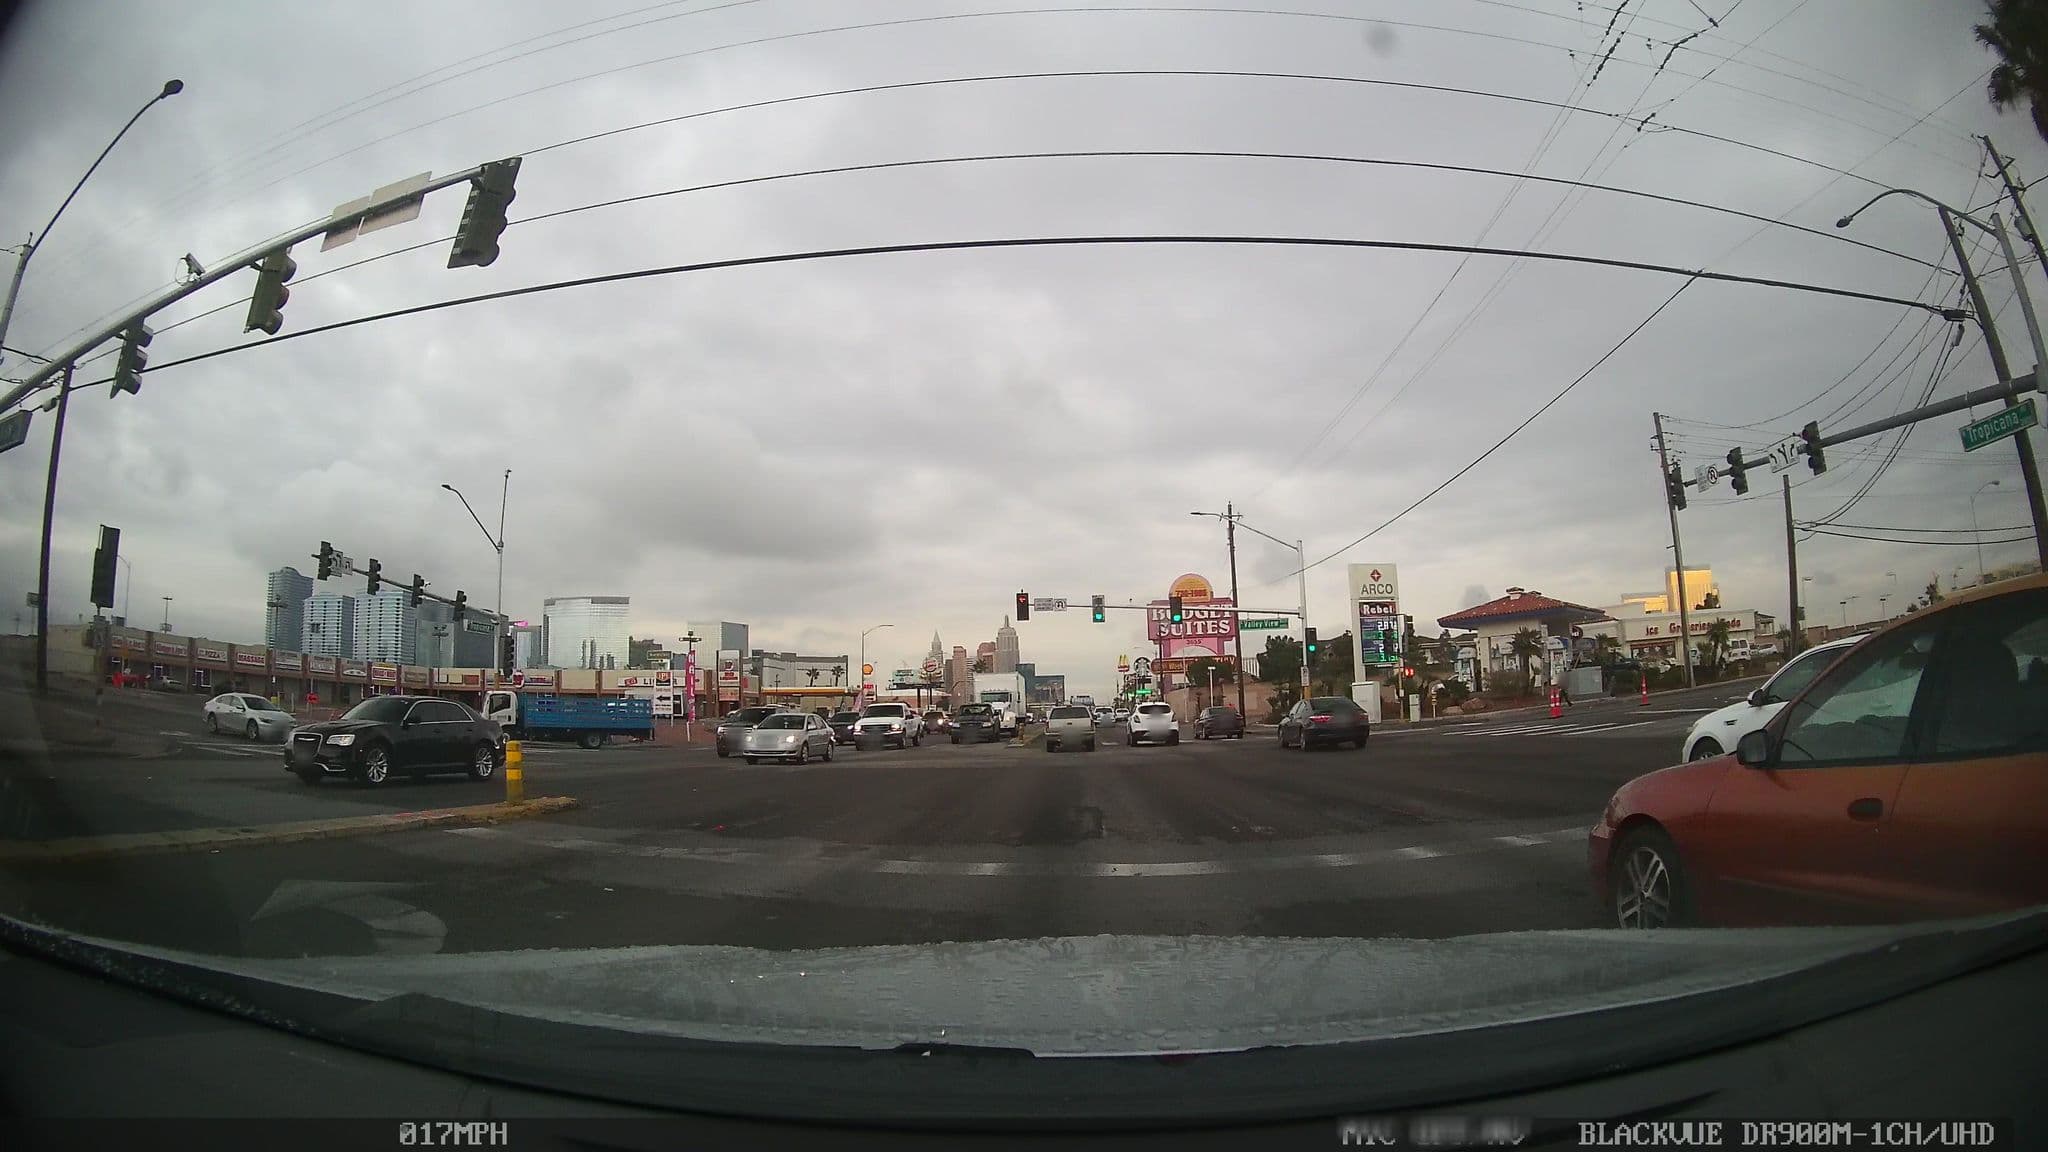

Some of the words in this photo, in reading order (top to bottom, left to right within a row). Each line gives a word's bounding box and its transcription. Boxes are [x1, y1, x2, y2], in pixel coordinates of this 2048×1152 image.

[1966, 412, 2020, 443] Tropicana
[1360, 583, 1394, 595] ARCO
[1362, 604, 1393, 615] Rebel
[1156, 619, 1231, 637] SUITES
[1243, 618, 1263, 629] Valley
[1263, 618, 1280, 628] View
[1669, 620, 1712, 634] Greries
